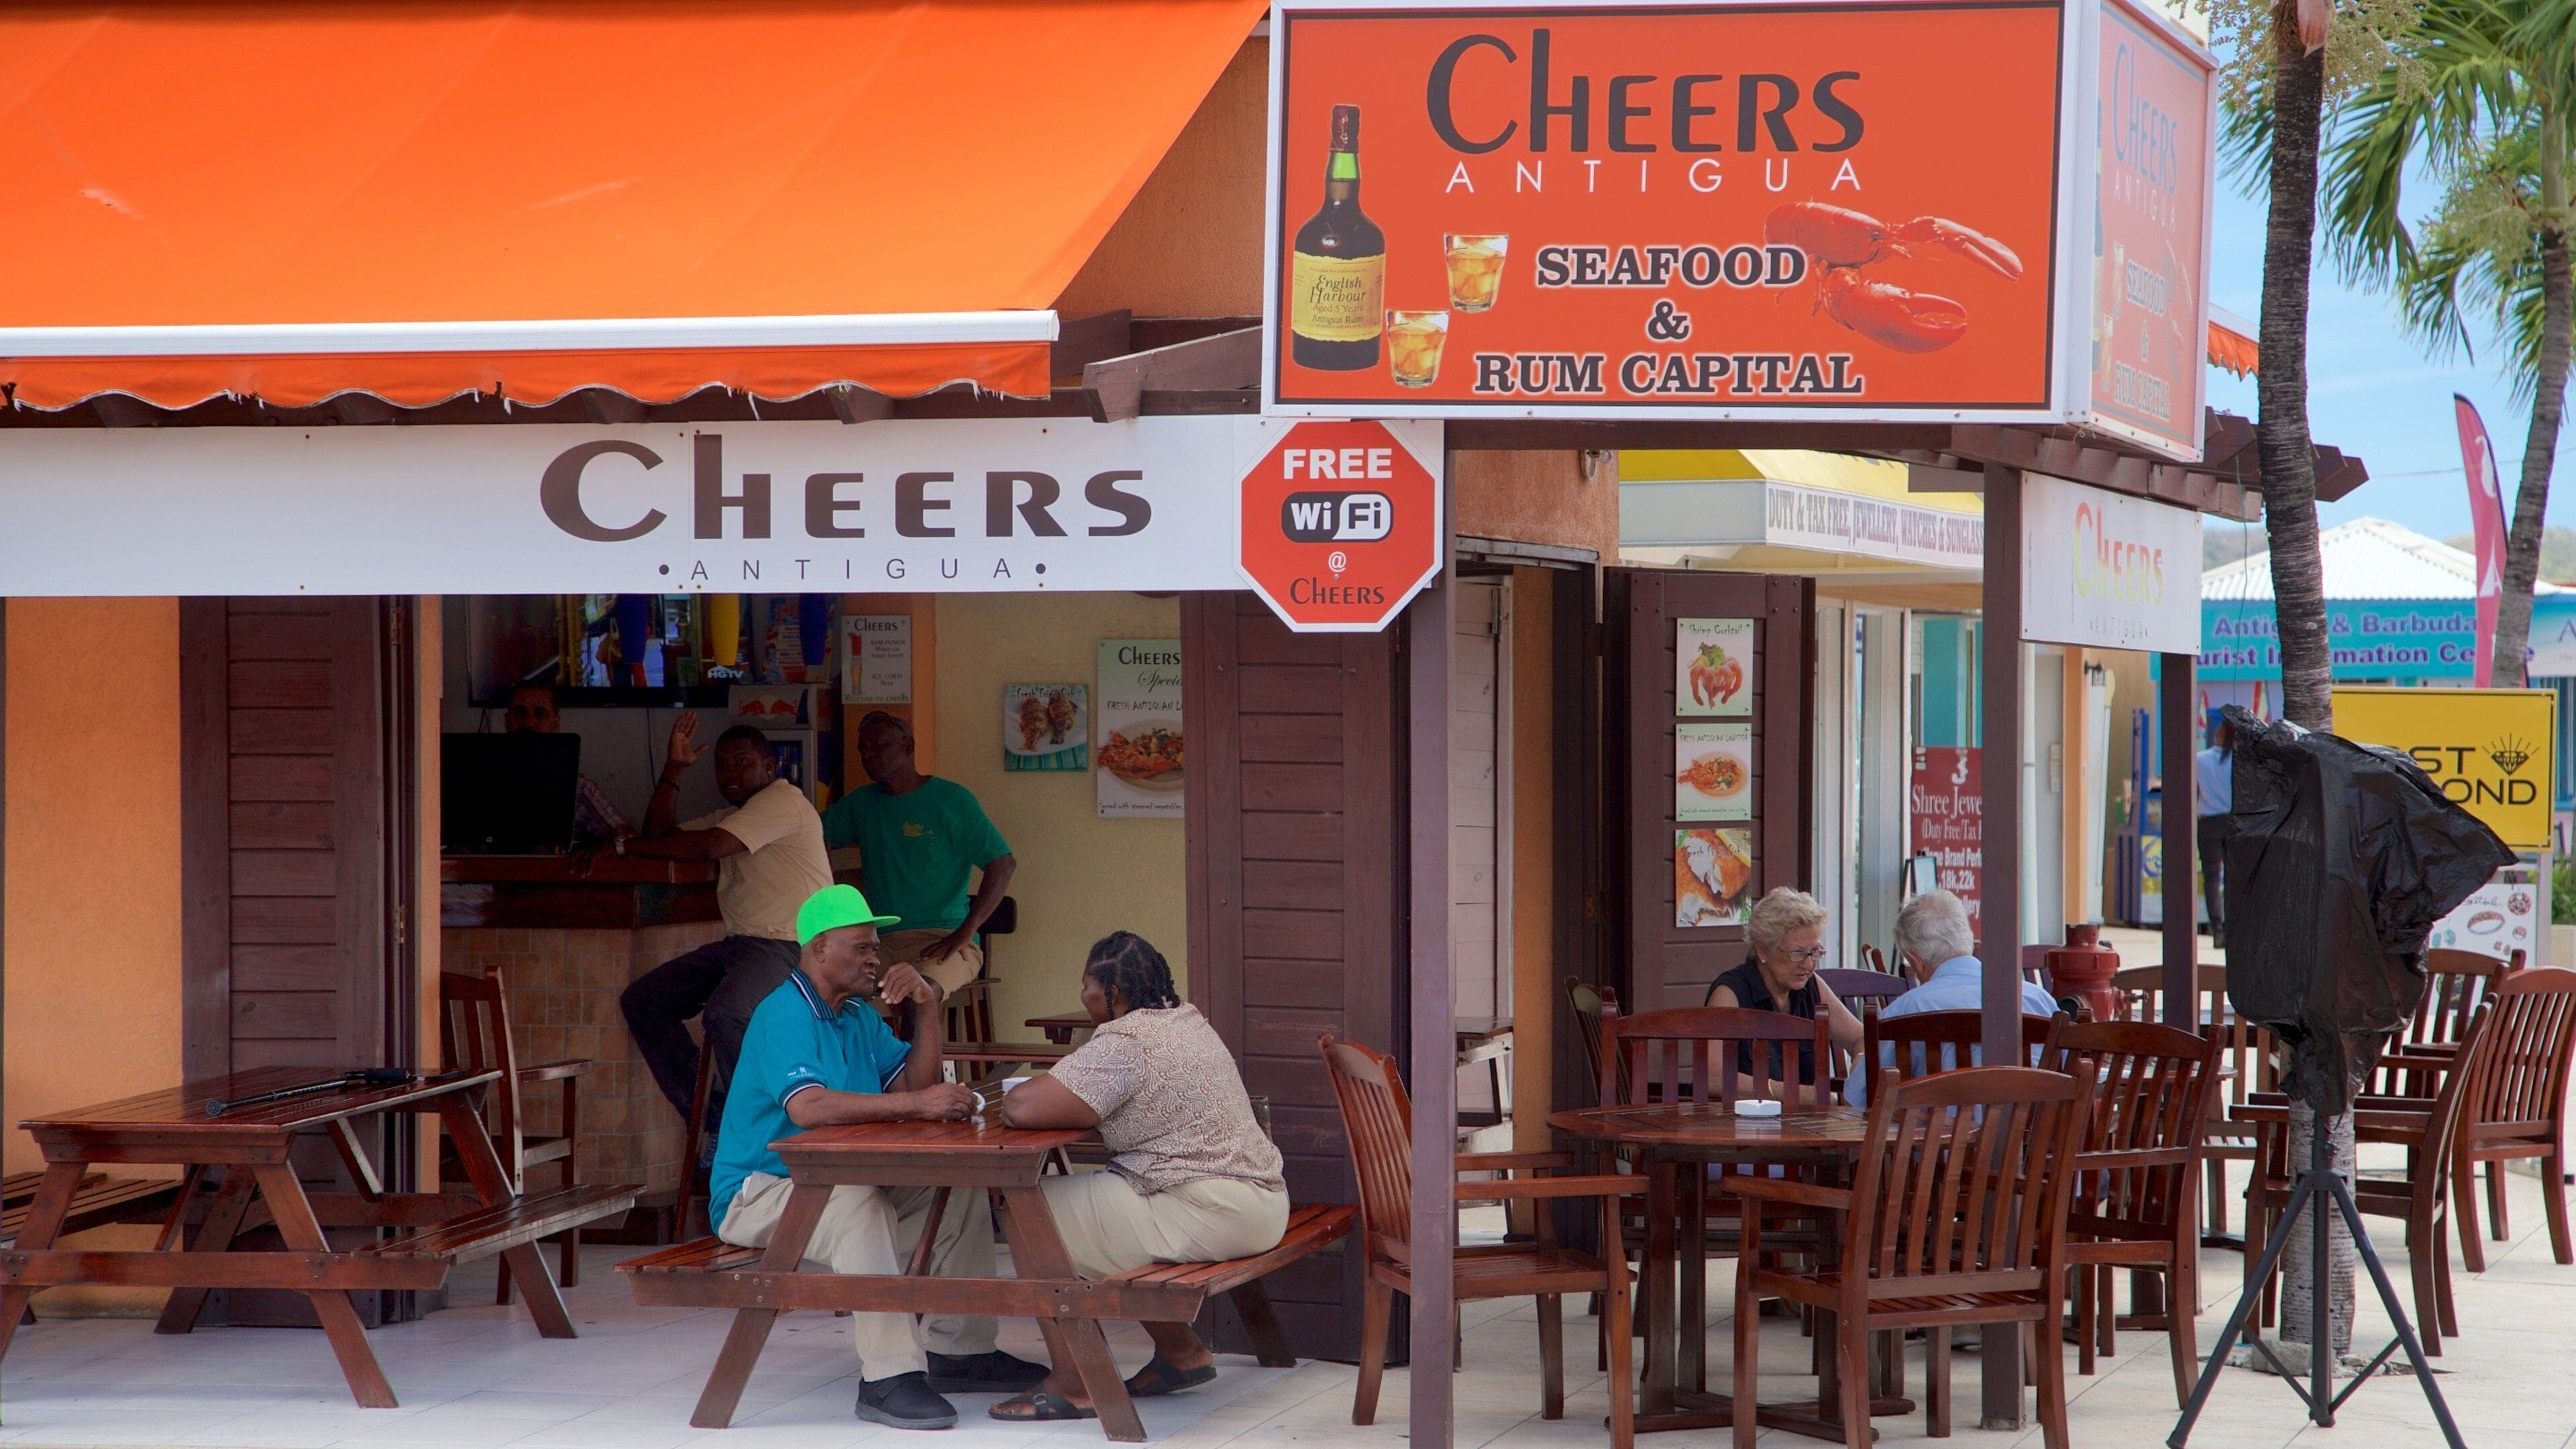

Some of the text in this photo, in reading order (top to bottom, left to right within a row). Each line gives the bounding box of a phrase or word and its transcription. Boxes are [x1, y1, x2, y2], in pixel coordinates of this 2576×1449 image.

[1445, 158, 1862, 193] ANTIGUA
[2113, 168, 2176, 232] ANTIGUA
[1536, 246, 1806, 287] SEAFOOD
[1309, 286, 1366, 304] Harbour
[1316, 274, 1362, 292] English
[2127, 259, 2167, 317] SEAFOOD
[1311, 315, 1363, 325] Antigua Rum
[1313, 304, 1332, 314] Aged
[1342, 305, 1364, 313] Years
[1647, 300, 1690, 340] &
[1474, 354, 1864, 394] RUM CAPITAL
[2114, 361, 2170, 422] RUM CAPITAL
[1283, 447, 1393, 480] FREE
[1768, 487, 1795, 530] DUTY
[1797, 492, 1805, 532] &
[1807, 494, 1826, 534] TAX
[1827, 496, 1851, 545] FREE,
[1852, 500, 1898, 552] JEWELLERY,
[1900, 508, 1937, 550] WATCHES
[1938, 517, 1945, 552] &
[691, 557, 1012, 581] ANTIGUA
[1328, 551, 1347, 572] @
[1688, 623, 1743, 637] Shrimp Cocktail
[2214, 611, 2477, 641] Antig & Barbuda
[2197, 642, 2536, 665] urist Imation Cee
[708, 669, 744, 678] HGTV
[1107, 701, 1129, 710] FRESH
[1133, 701, 1173, 710] ANTIGUAN
[2408, 746, 2476, 775] ST
[1912, 784, 1982, 819] Shree Jewe
[2442, 778, 2537, 805] OND
[1945, 847, 1965, 867] Brand
[1966, 847, 1982, 867] Perf
[1963, 895, 1981, 920] llery
